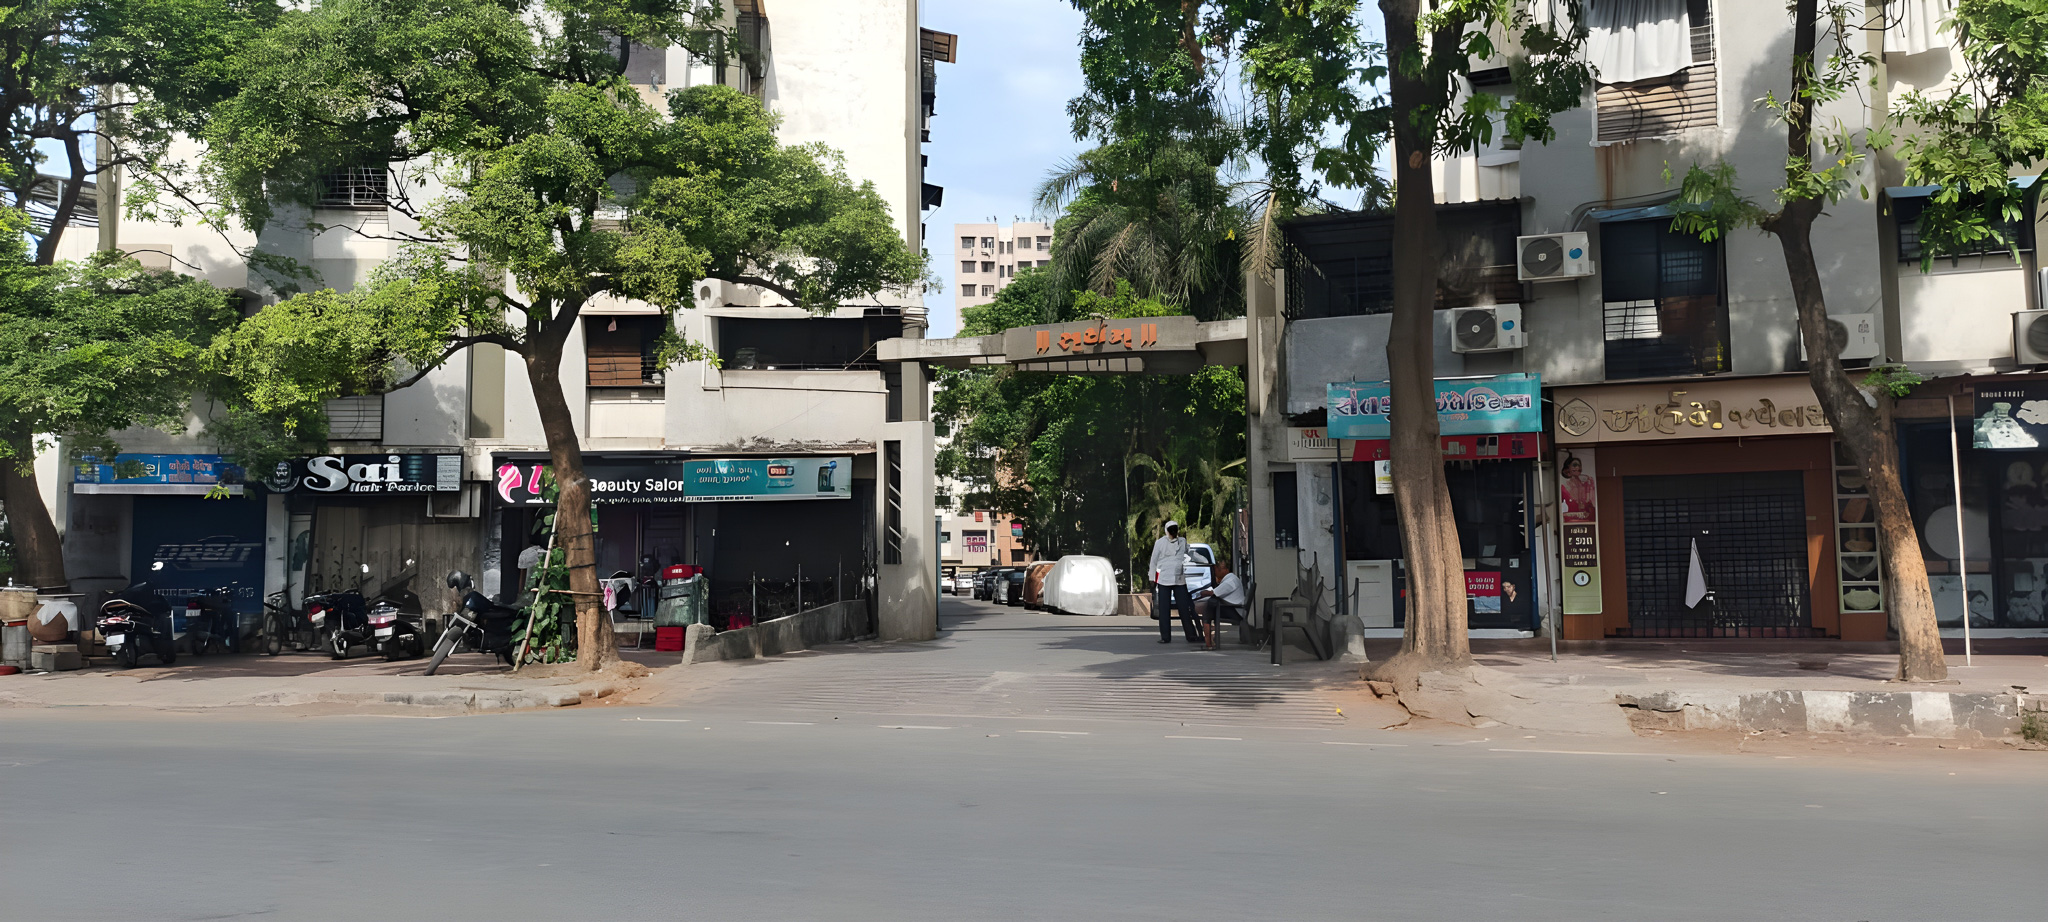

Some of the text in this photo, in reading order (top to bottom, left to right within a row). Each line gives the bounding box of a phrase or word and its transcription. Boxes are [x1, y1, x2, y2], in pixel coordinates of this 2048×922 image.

[303, 455, 404, 492] Sai
[350, 482, 383, 492] Hair
[590, 478, 641, 493] Beauty
